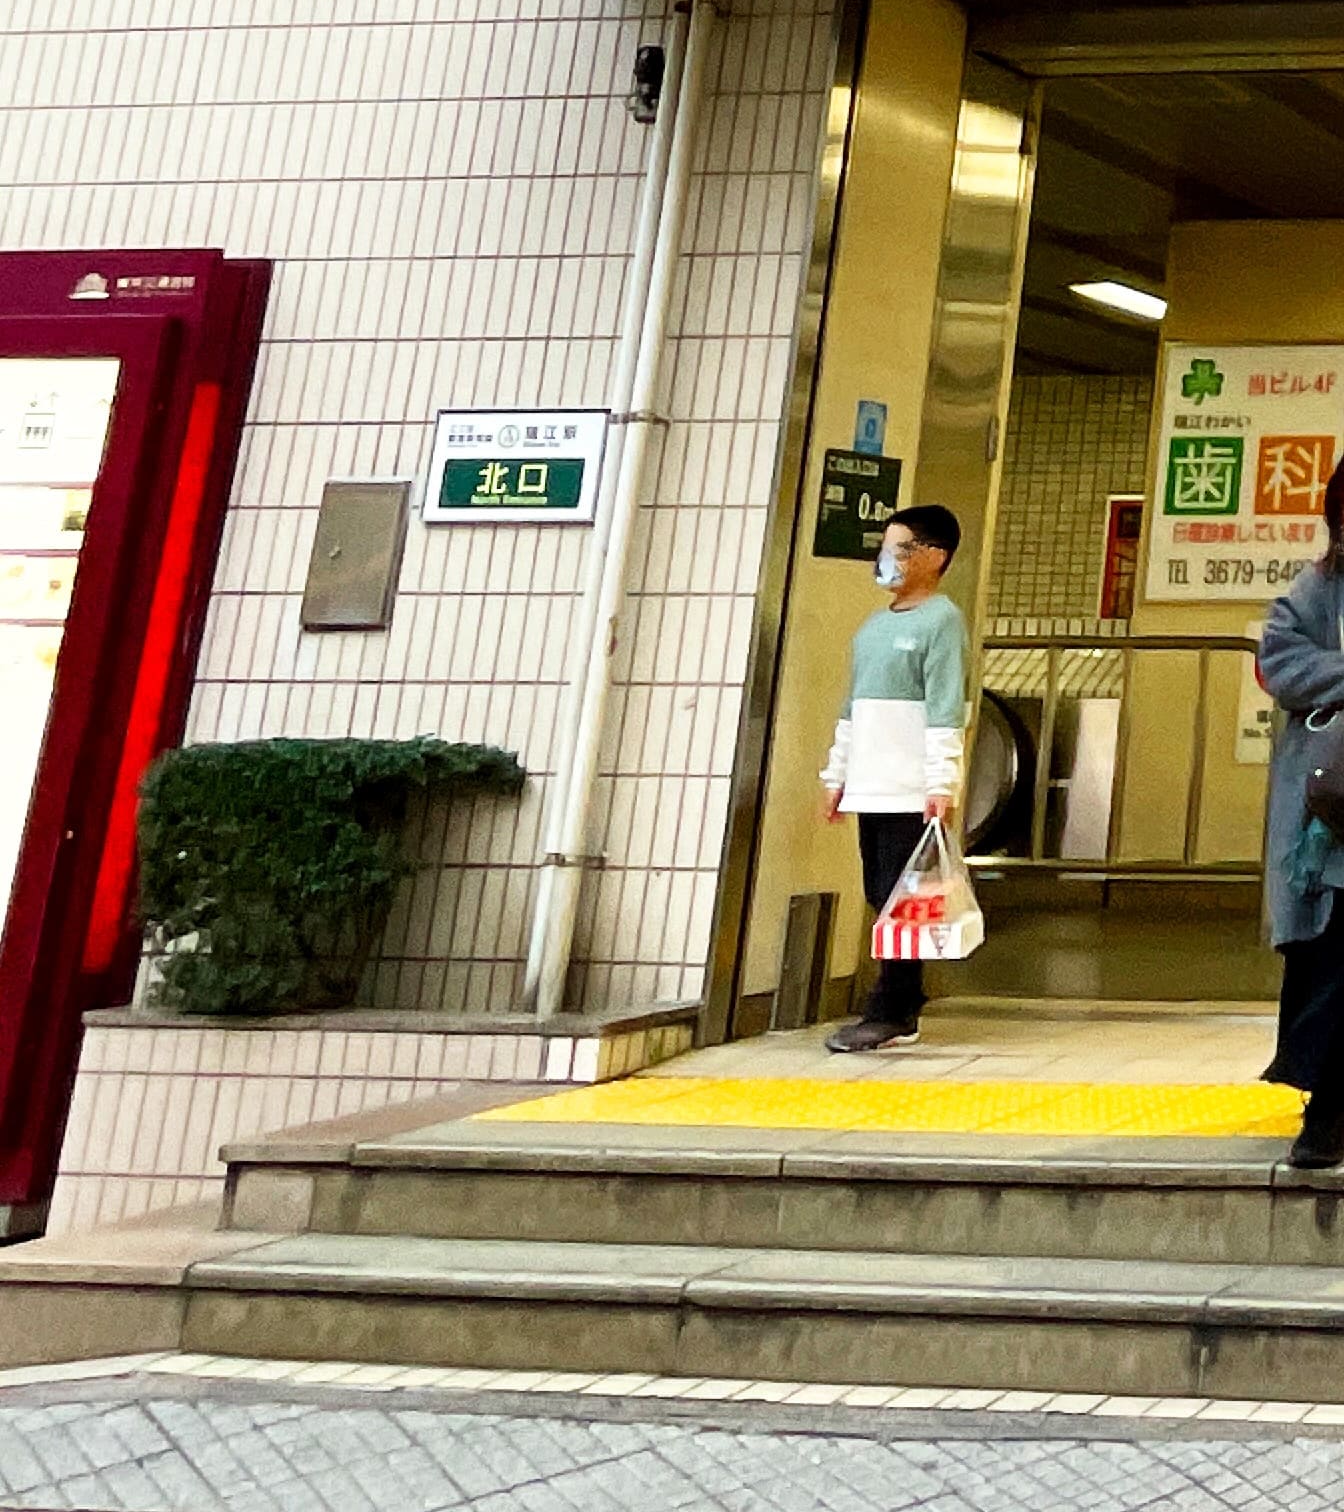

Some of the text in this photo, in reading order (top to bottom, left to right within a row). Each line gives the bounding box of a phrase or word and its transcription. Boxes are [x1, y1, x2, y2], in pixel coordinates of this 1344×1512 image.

[476, 462, 548, 494] 北口
[1174, 442, 1328, 511] 歯科
[1168, 560, 1189, 584] TEL
